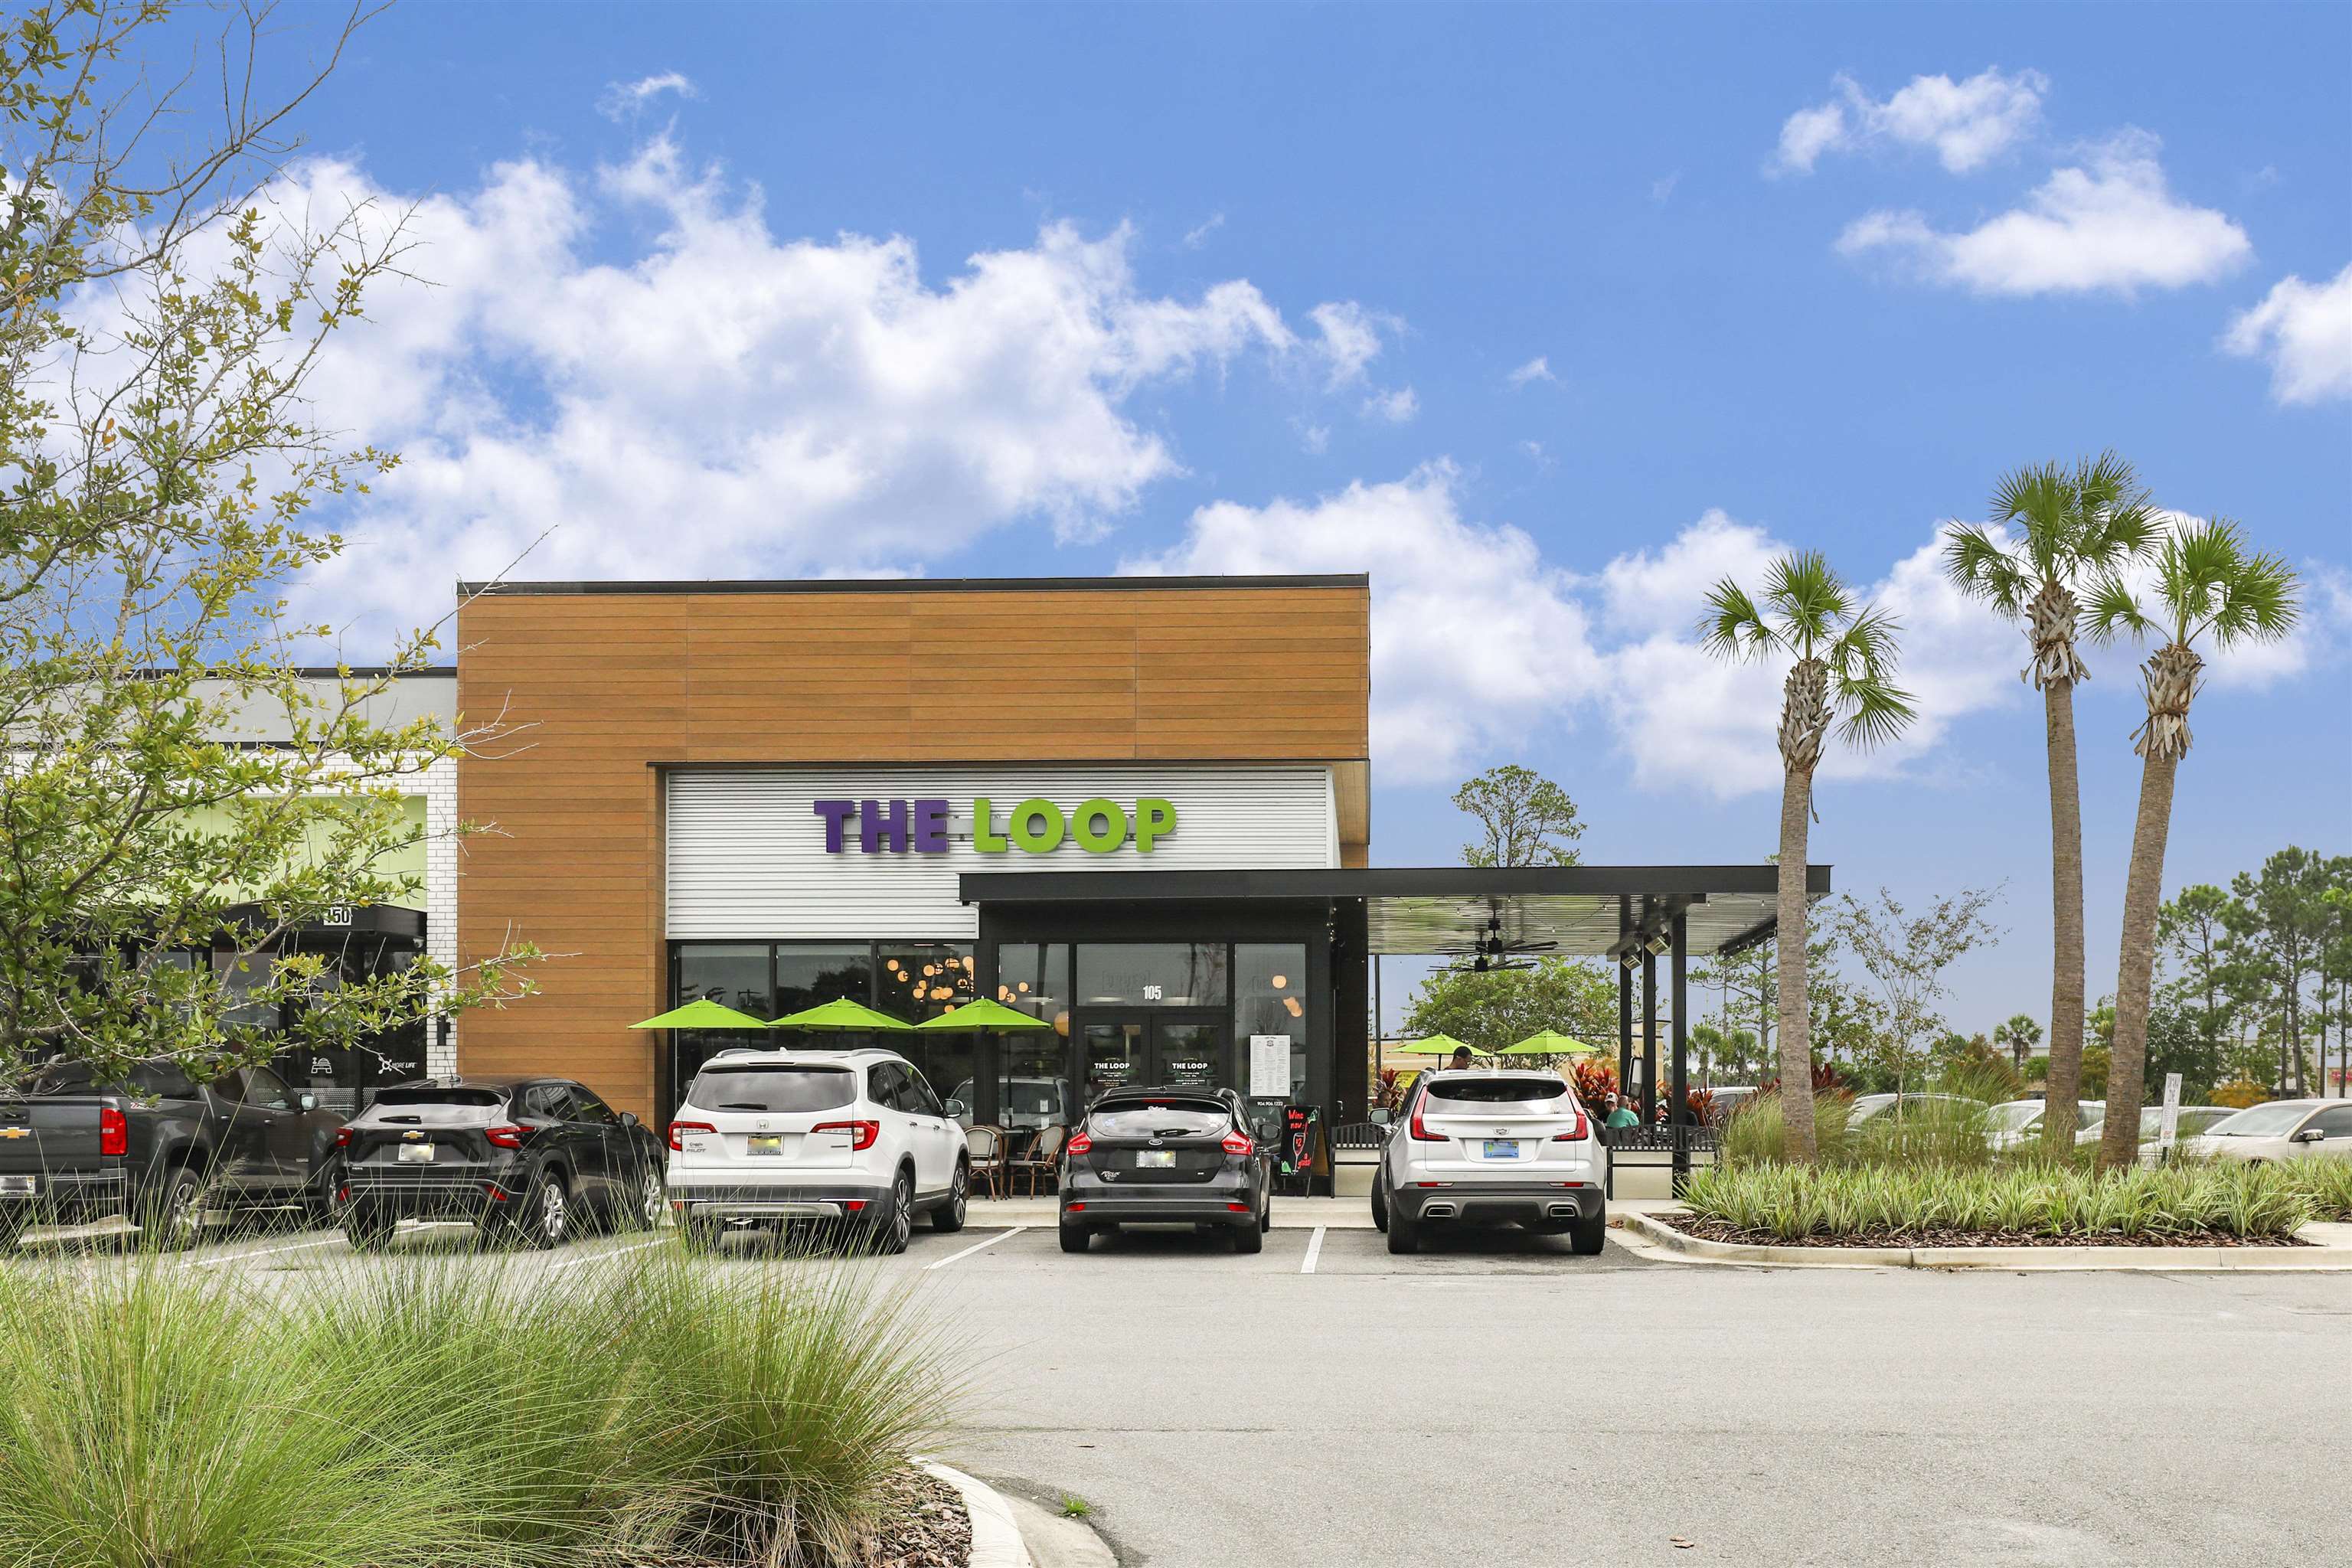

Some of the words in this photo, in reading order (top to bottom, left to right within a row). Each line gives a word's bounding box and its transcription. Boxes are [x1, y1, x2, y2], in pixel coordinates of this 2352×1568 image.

[814, 799, 949, 854] THE
[974, 798, 1178, 854] LOOP
[1143, 985, 1162, 1000] 105
